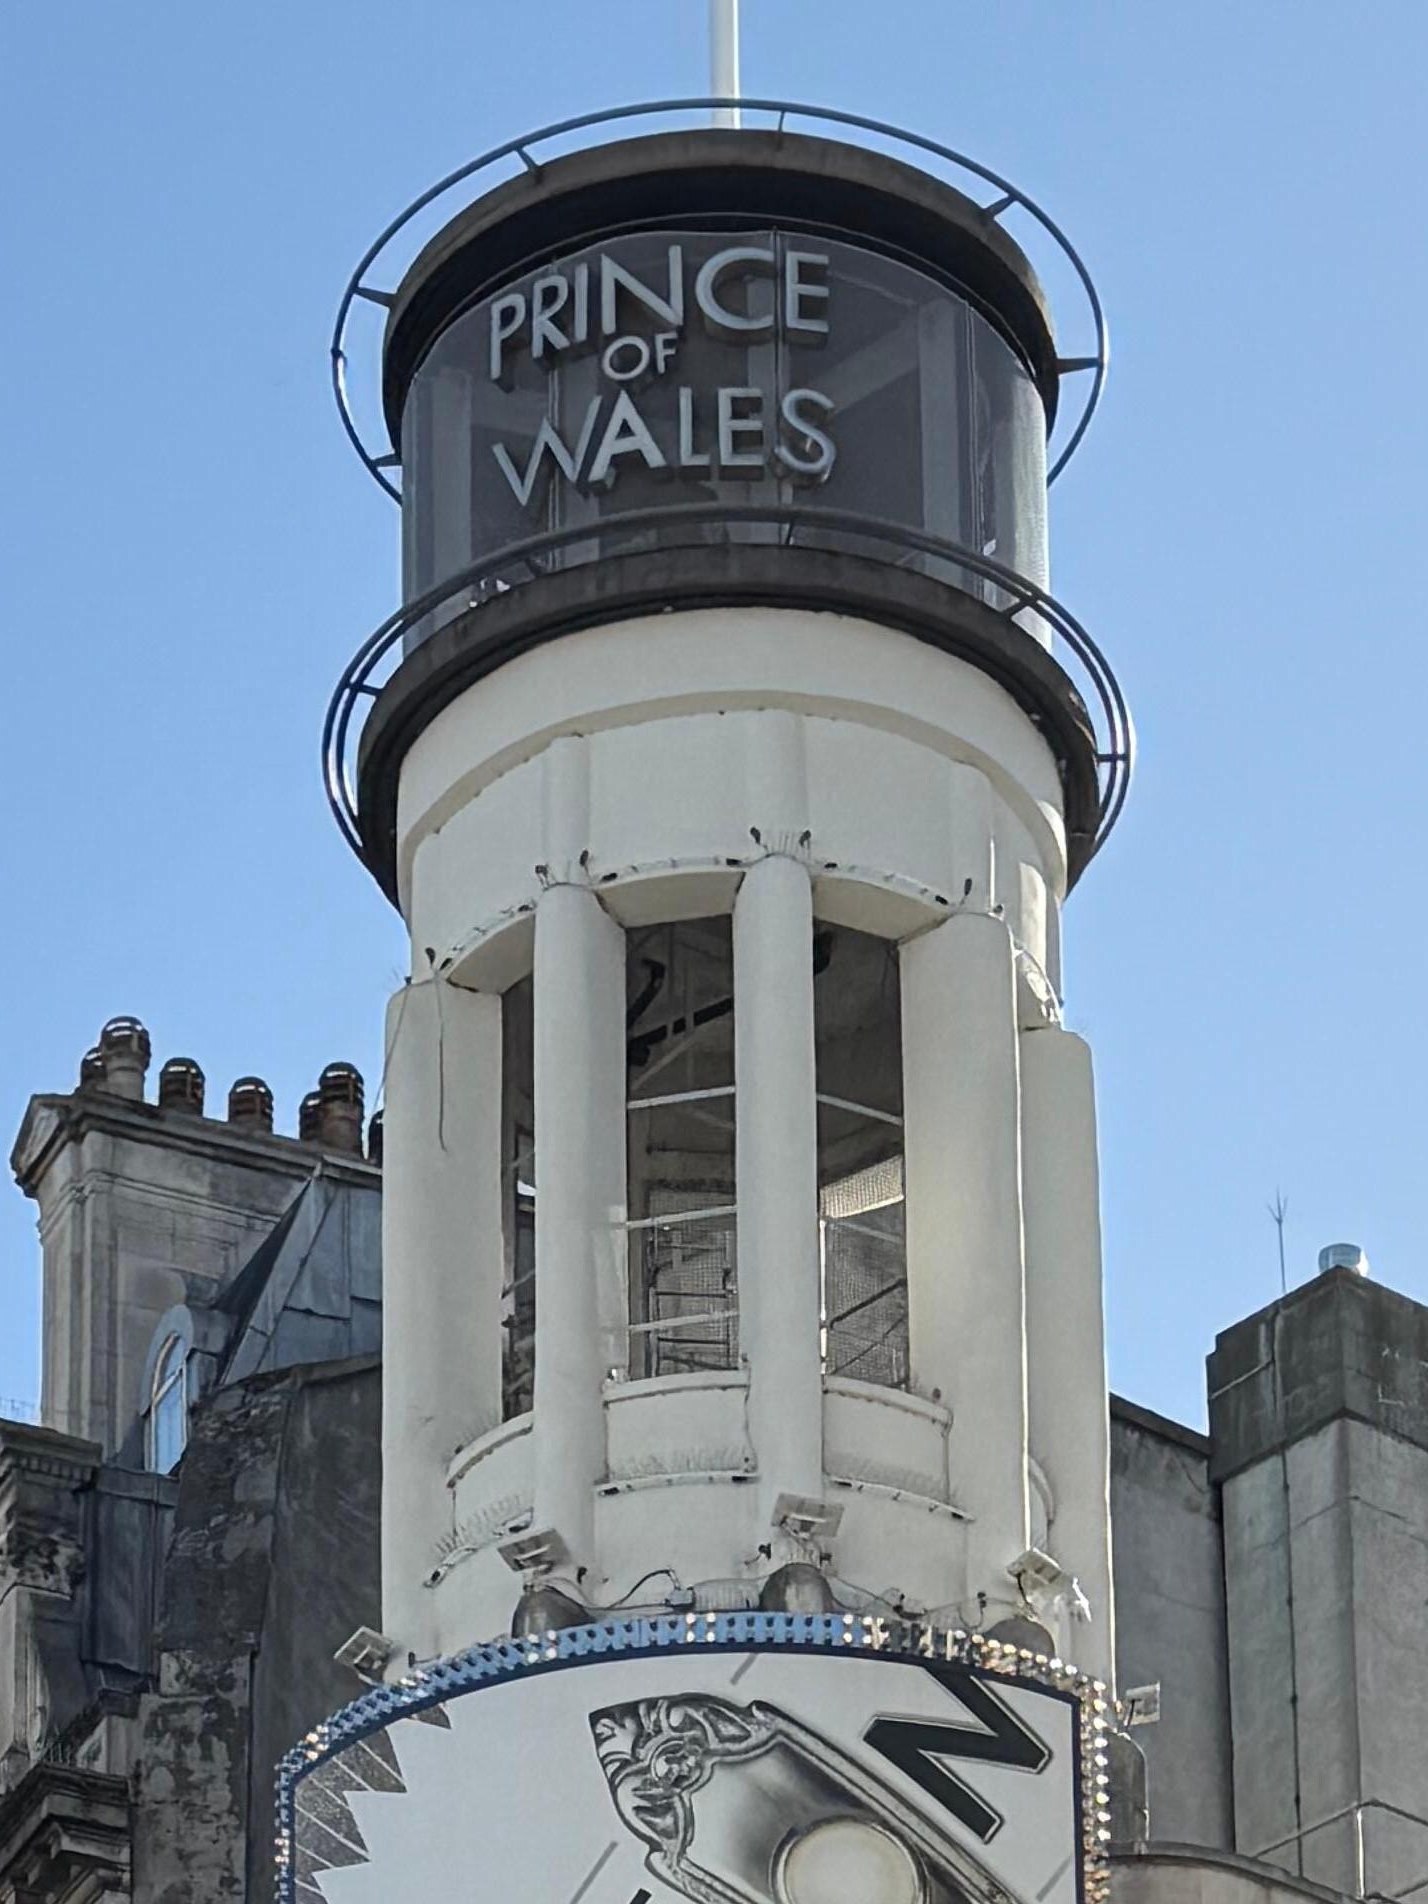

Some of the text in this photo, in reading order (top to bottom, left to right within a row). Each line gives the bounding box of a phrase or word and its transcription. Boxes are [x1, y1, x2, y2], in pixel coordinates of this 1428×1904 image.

[489, 244, 830, 380] PRINCE
[601, 331, 679, 382] OF
[492, 387, 838, 507] WALES
